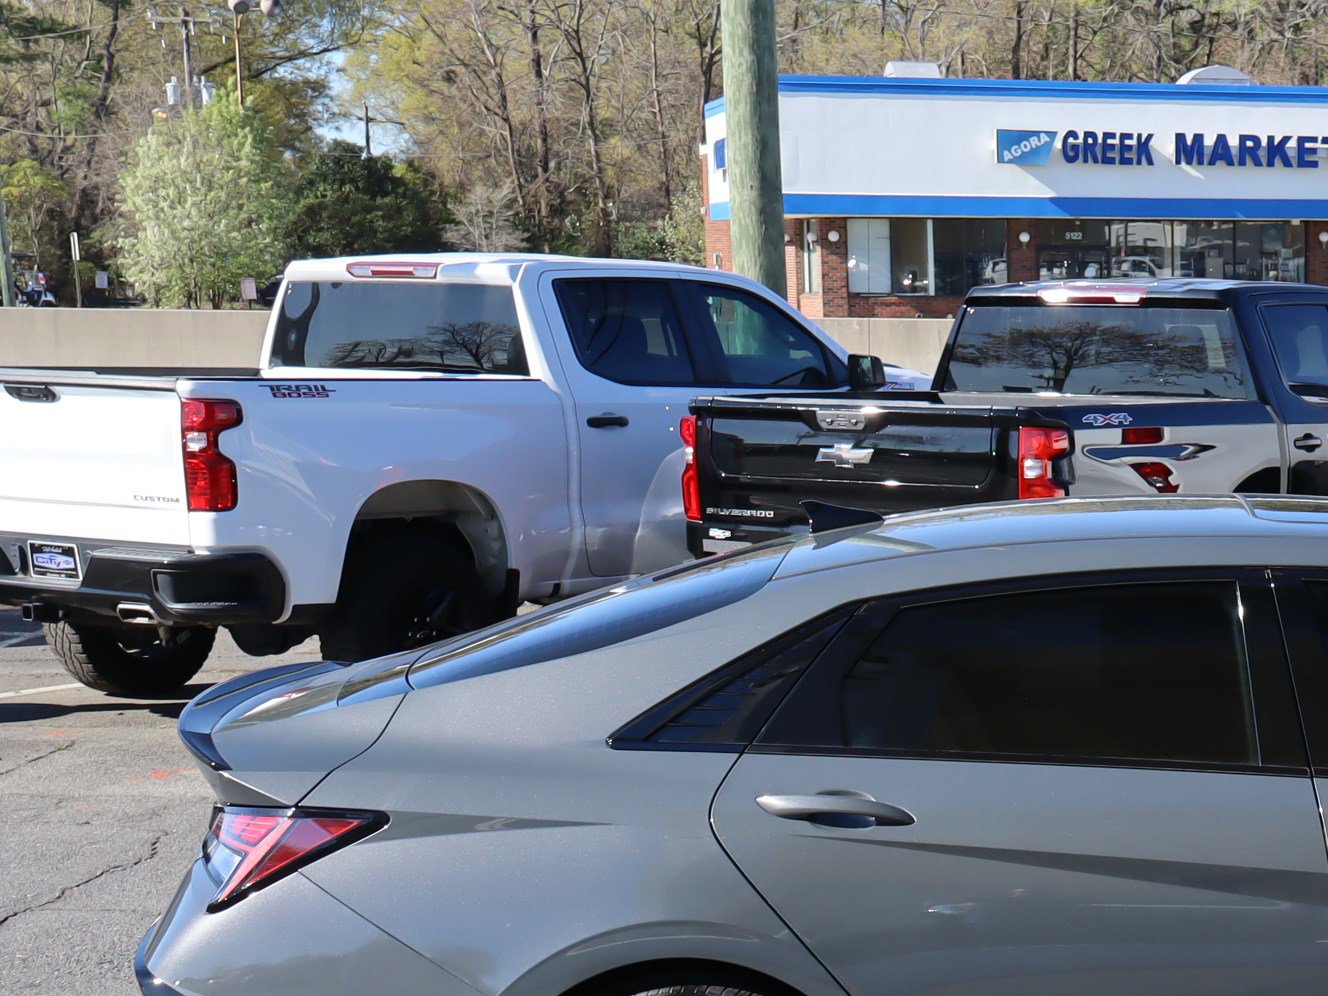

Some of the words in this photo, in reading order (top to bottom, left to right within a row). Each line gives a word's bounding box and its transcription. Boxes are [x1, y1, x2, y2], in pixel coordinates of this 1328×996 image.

[1002, 132, 1051, 163] AGORA
[1061, 130, 1155, 166] GREEK
[1065, 231, 1083, 240] 5122
[258, 384, 337, 392] TRAIL
[133, 494, 181, 503] CUSTOM
[705, 507, 775, 518] SILVERADO
